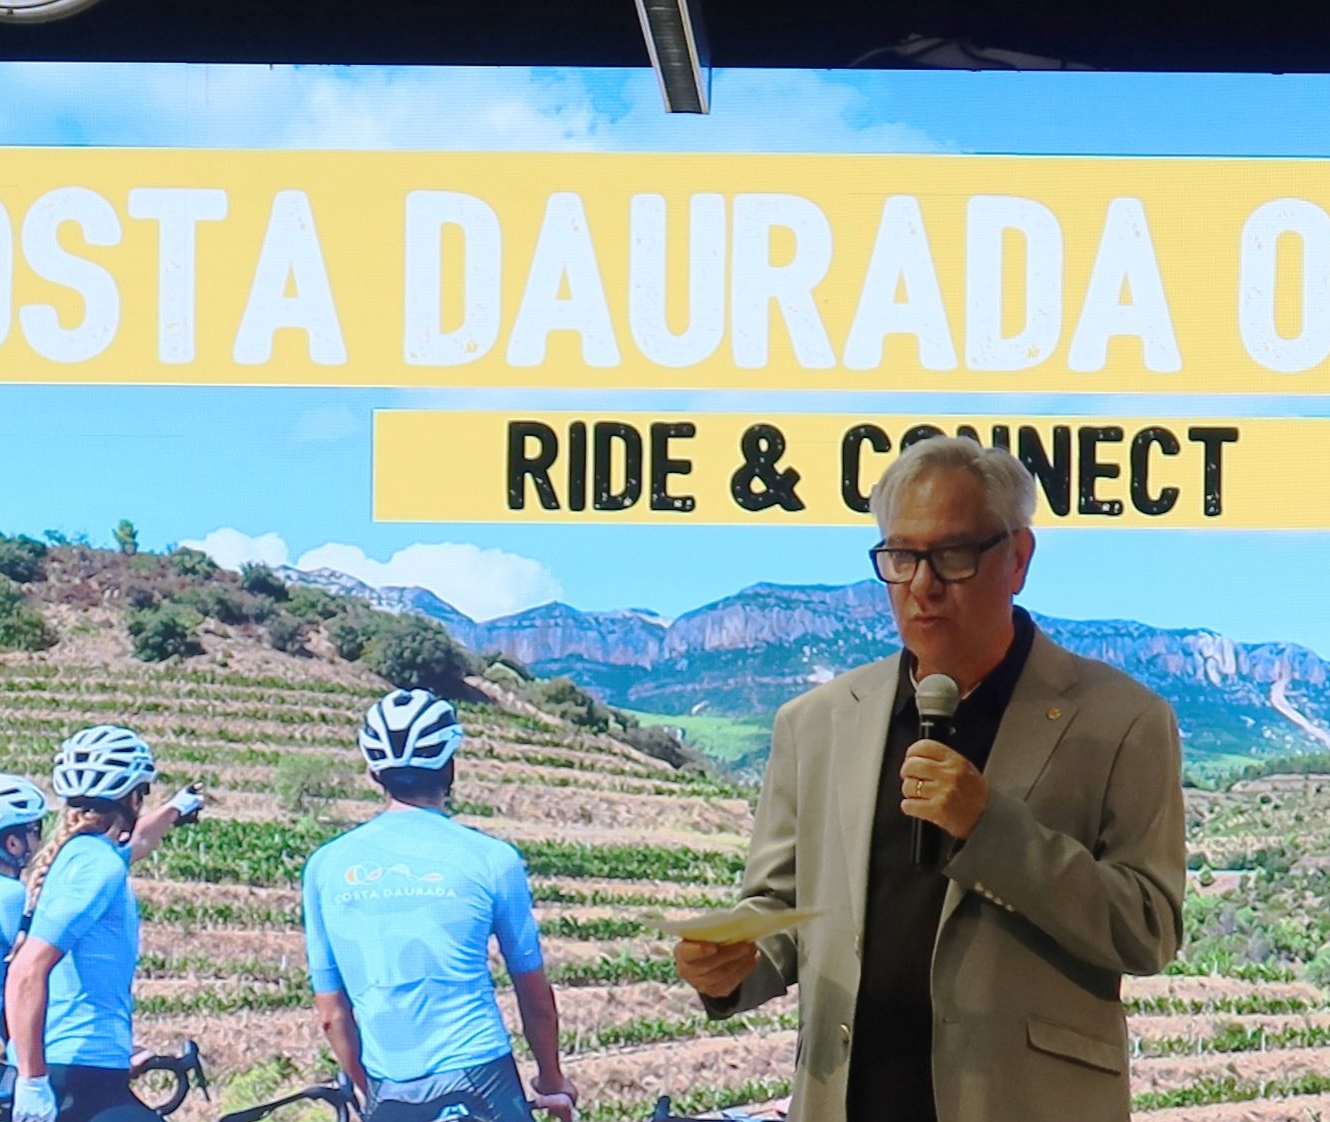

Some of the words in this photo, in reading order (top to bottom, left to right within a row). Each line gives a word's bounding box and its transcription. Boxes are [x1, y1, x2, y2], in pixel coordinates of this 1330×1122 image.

[403, 189, 1183, 374] DAURADA
[507, 421, 696, 513] RIDE
[730, 424, 806, 513] &
[841, 424, 1239, 517] CNECT
